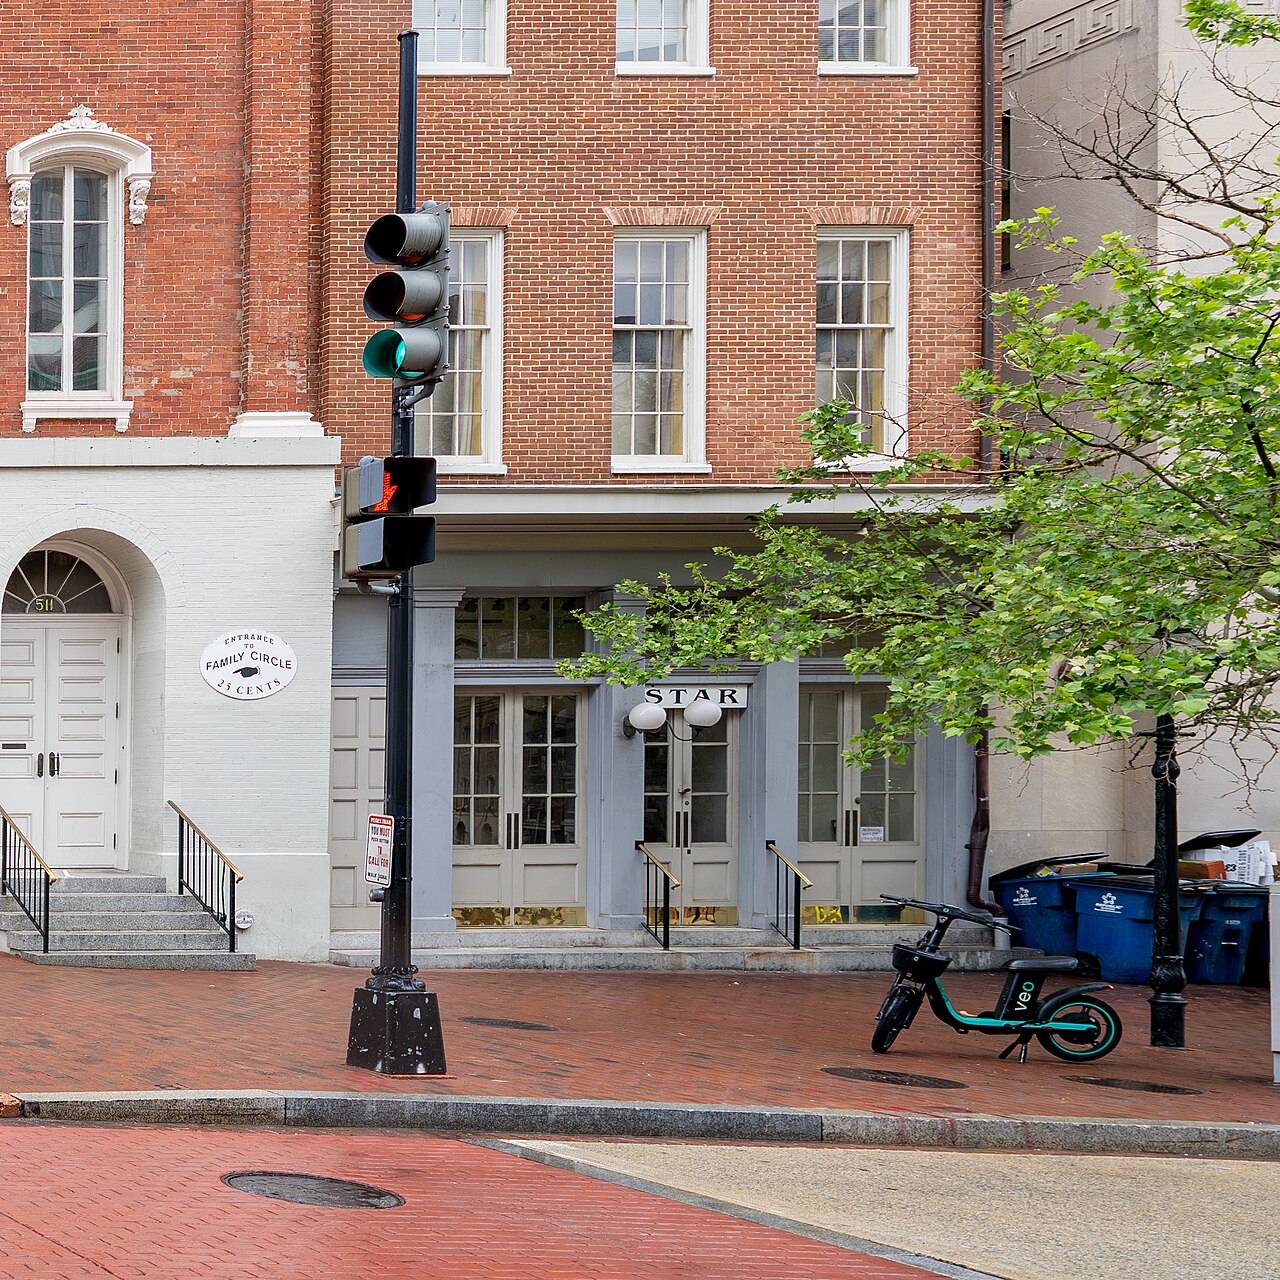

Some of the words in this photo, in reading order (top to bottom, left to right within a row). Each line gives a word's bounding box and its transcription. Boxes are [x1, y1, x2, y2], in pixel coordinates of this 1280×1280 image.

[35, 598, 54, 611] 511
[224, 633, 275, 645] ENTRANCE
[206, 651, 245, 671] FAMILY
[250, 650, 292, 670] CIRCLE
[217, 679, 232, 691] 25
[236, 677, 281, 695] CENTS
[645, 688, 739, 705] STAR
[371, 826, 379, 836] YOU
[379, 827, 390, 838] MUST
[377, 845, 383, 855] TO
[368, 855, 380, 867] CALL
[380, 857, 389, 868] FOR
[1014, 981, 1035, 1011] veo
